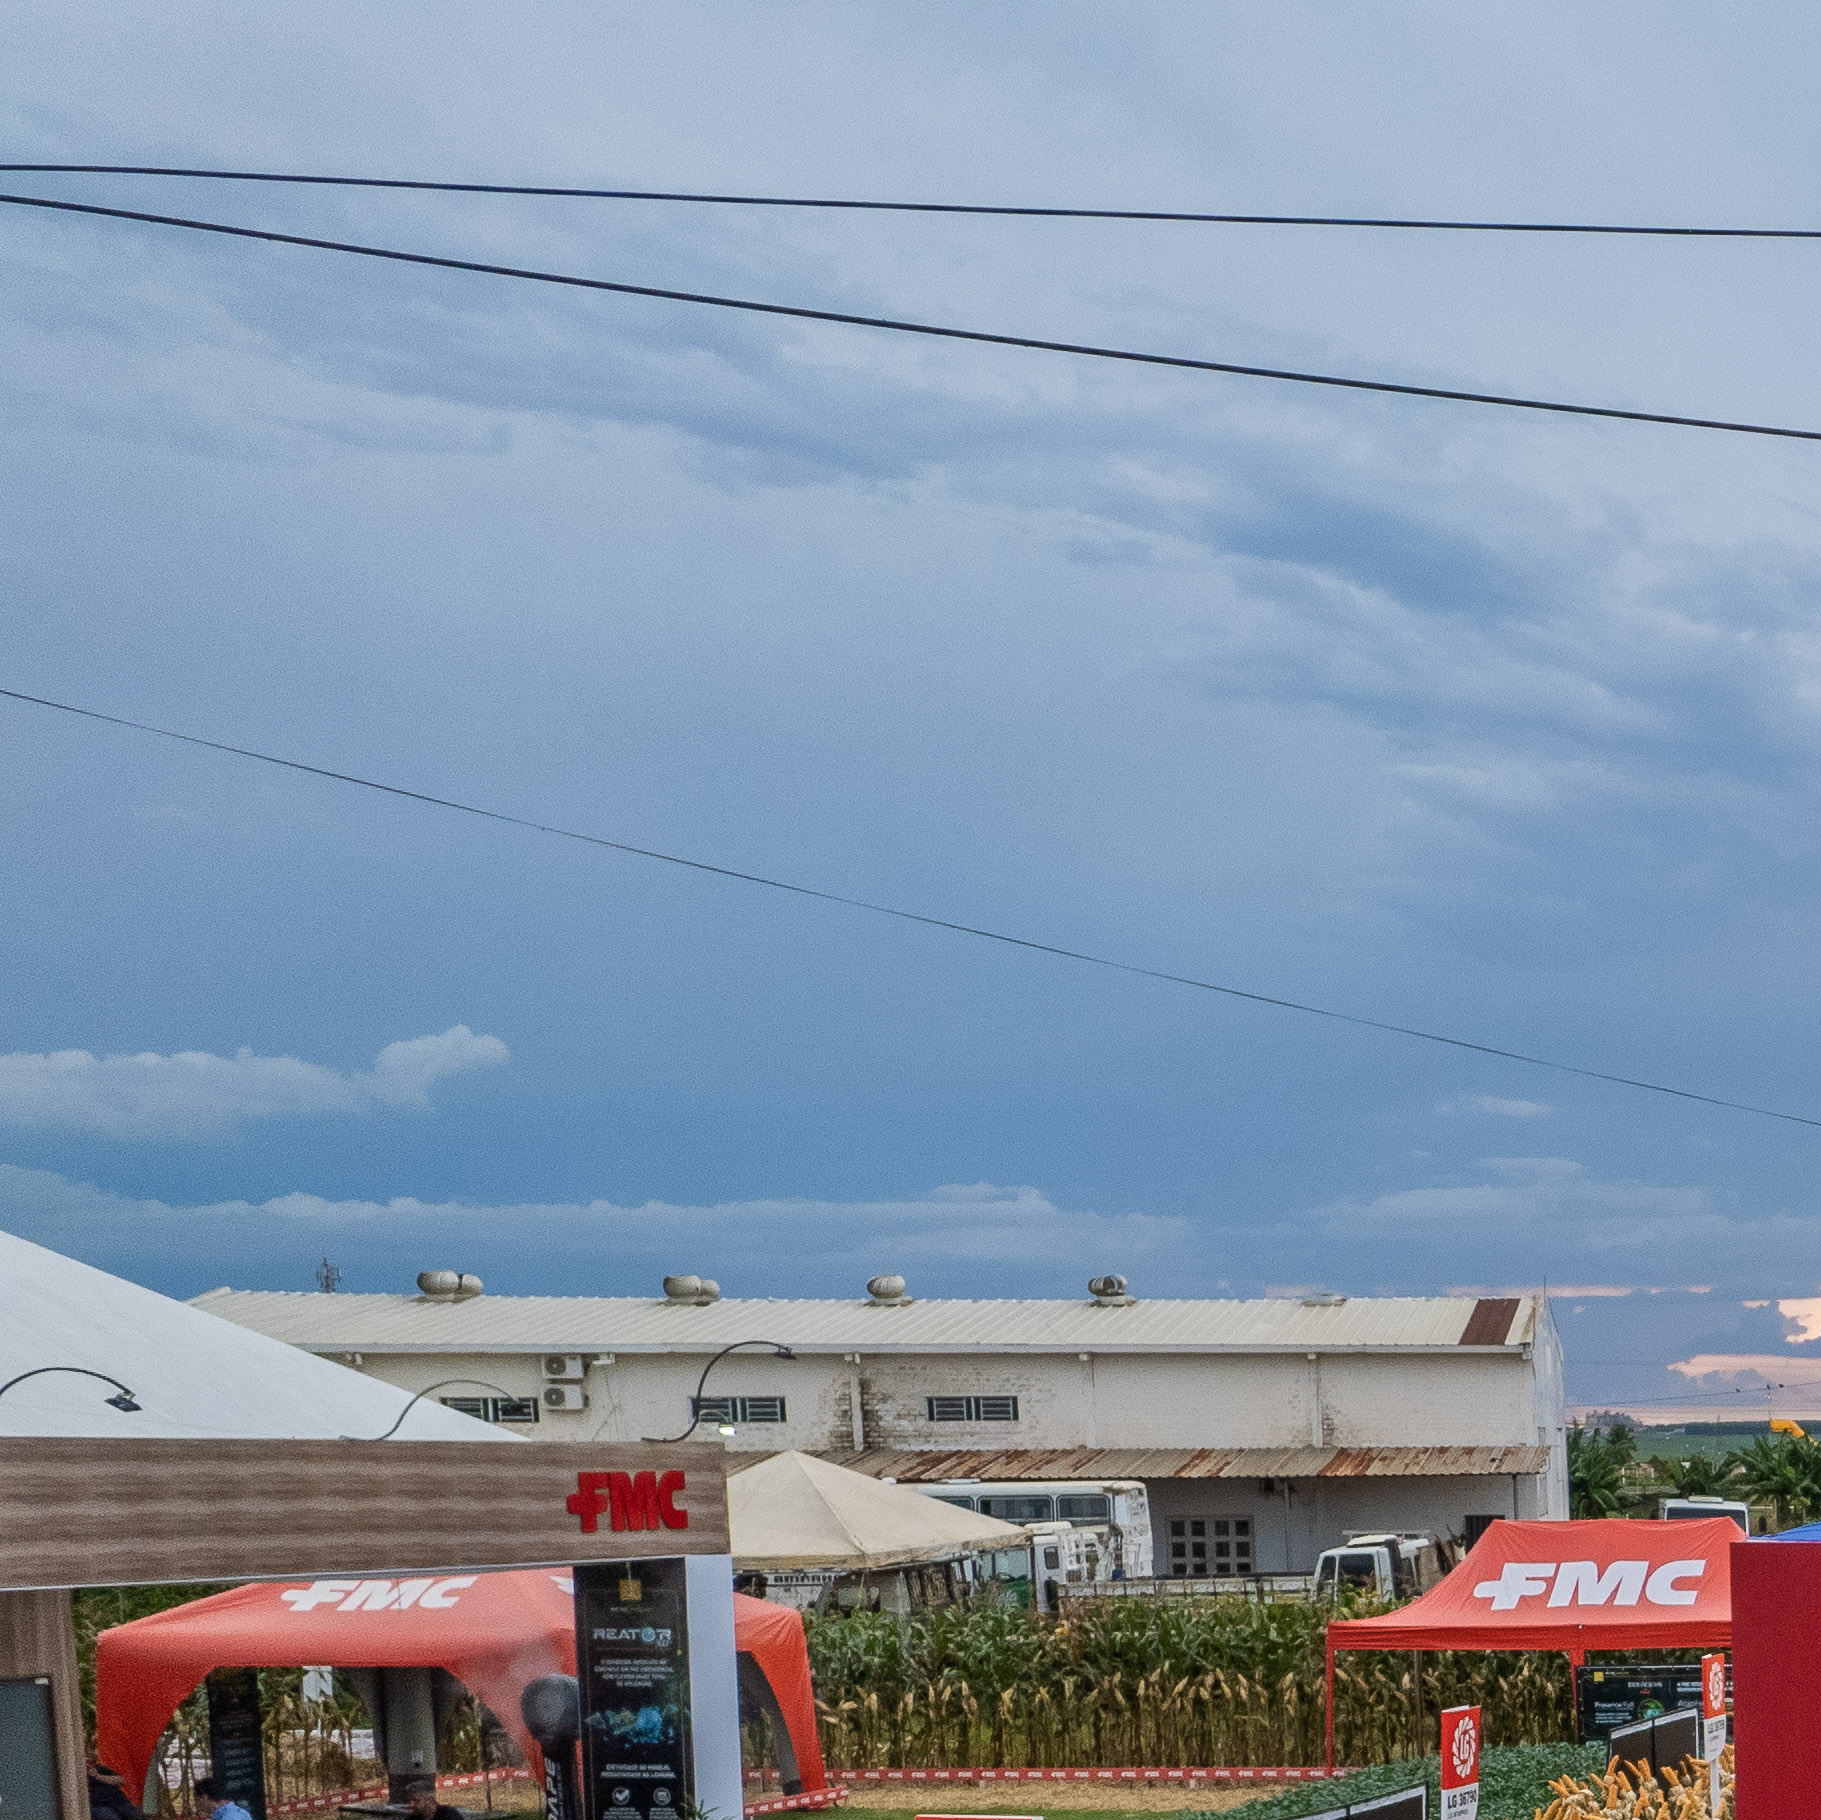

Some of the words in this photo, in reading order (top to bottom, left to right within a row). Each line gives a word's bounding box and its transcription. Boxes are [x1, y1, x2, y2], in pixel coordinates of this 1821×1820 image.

[566, 1469, 688, 1533] FMC
[280, 1576, 478, 1612] FMC
[1473, 1559, 1707, 1611] FMC
